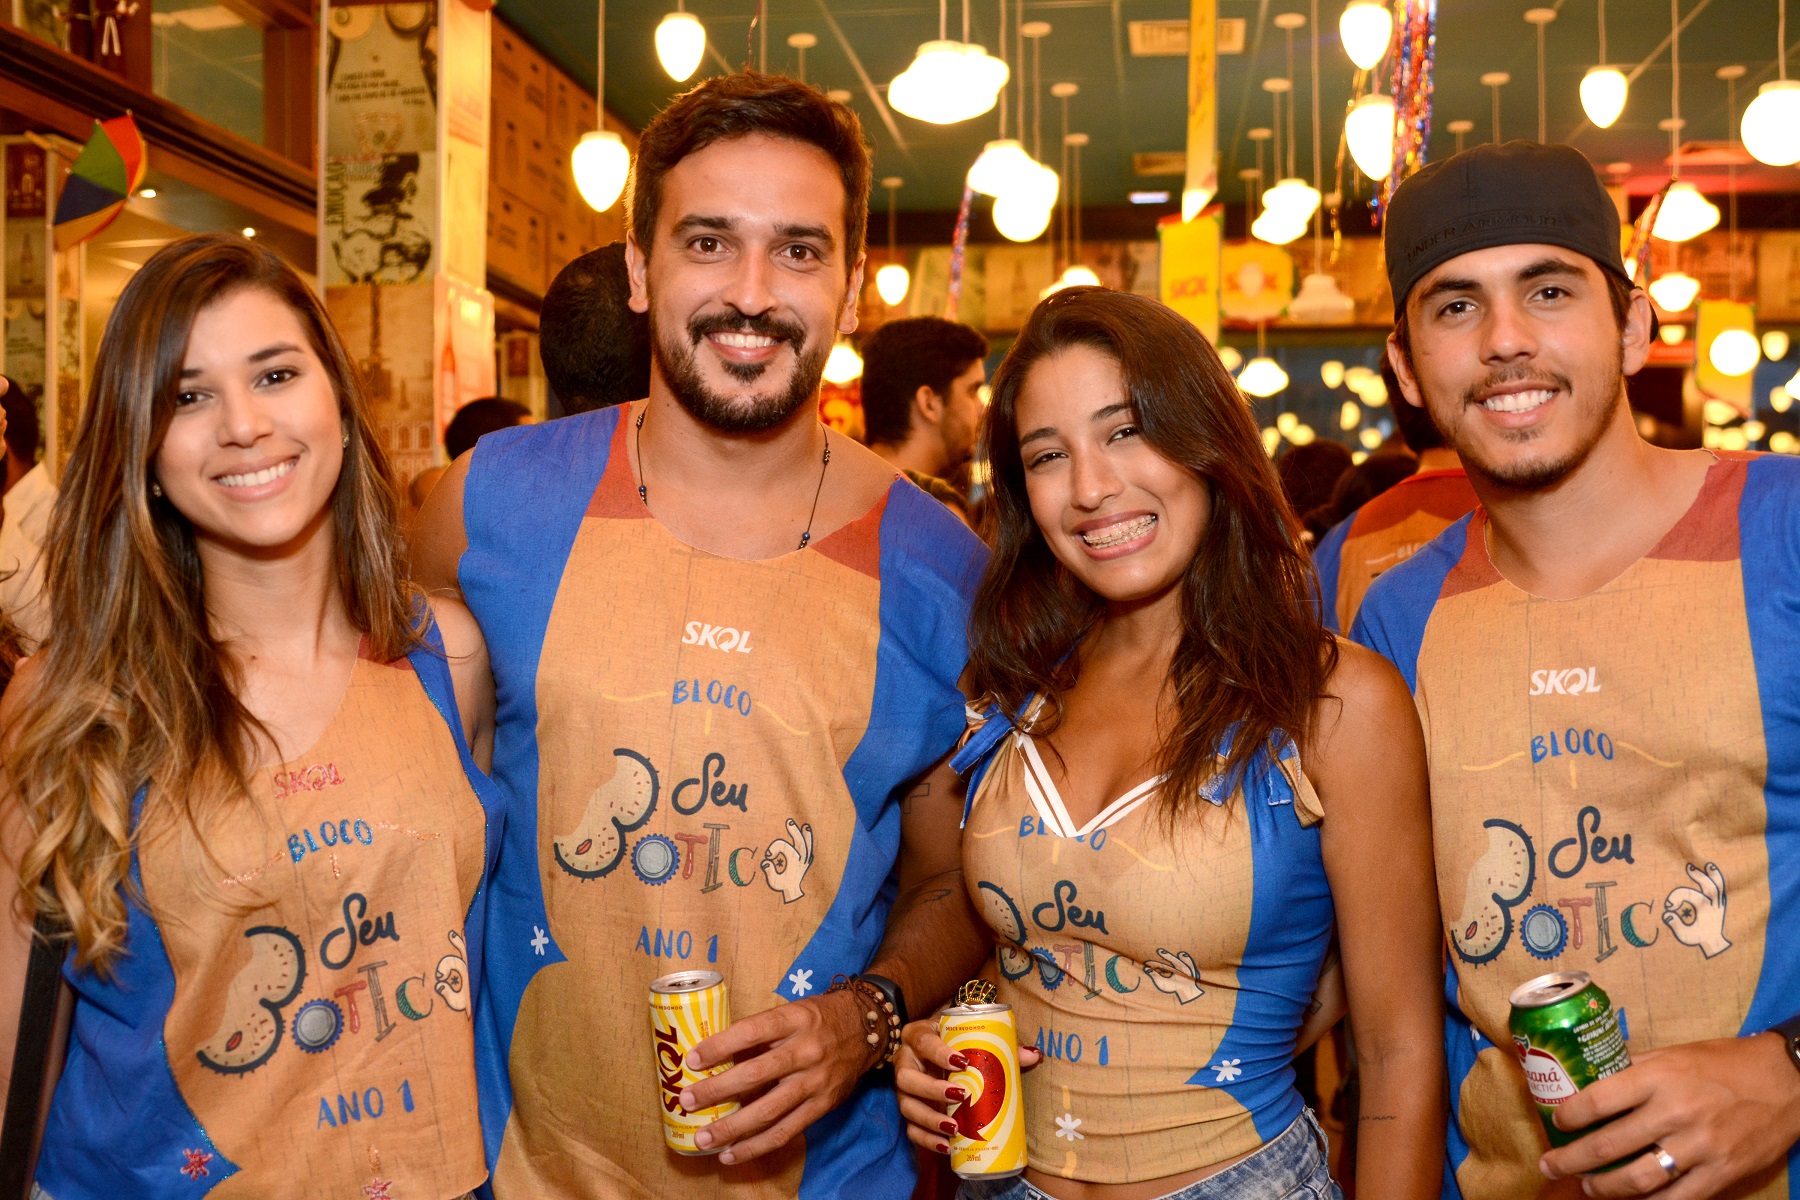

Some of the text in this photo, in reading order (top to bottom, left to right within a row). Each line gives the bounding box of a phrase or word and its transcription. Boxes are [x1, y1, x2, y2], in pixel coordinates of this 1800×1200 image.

[1407, 213, 1557, 262] UNDER ARMOUR
[681, 620, 753, 654] SKOL
[671, 679, 752, 716] BLOCO
[1529, 666, 1602, 697] SKOL
[1530, 727, 1614, 764] BLOCO
[273, 761, 346, 799] SKOL
[671, 752, 748, 816] Seu
[286, 817, 374, 864] BLOCO
[1019, 815, 1107, 851] BLO
[1548, 805, 1635, 879] Seu
[1032, 879, 1109, 936] Seu
[319, 892, 400, 970] Seu
[634, 924, 719, 964] ANO 1
[1035, 1027, 1109, 1066] ANO 1
[654, 1024, 688, 1118] SKOL
[317, 1079, 415, 1130] ANO 1
